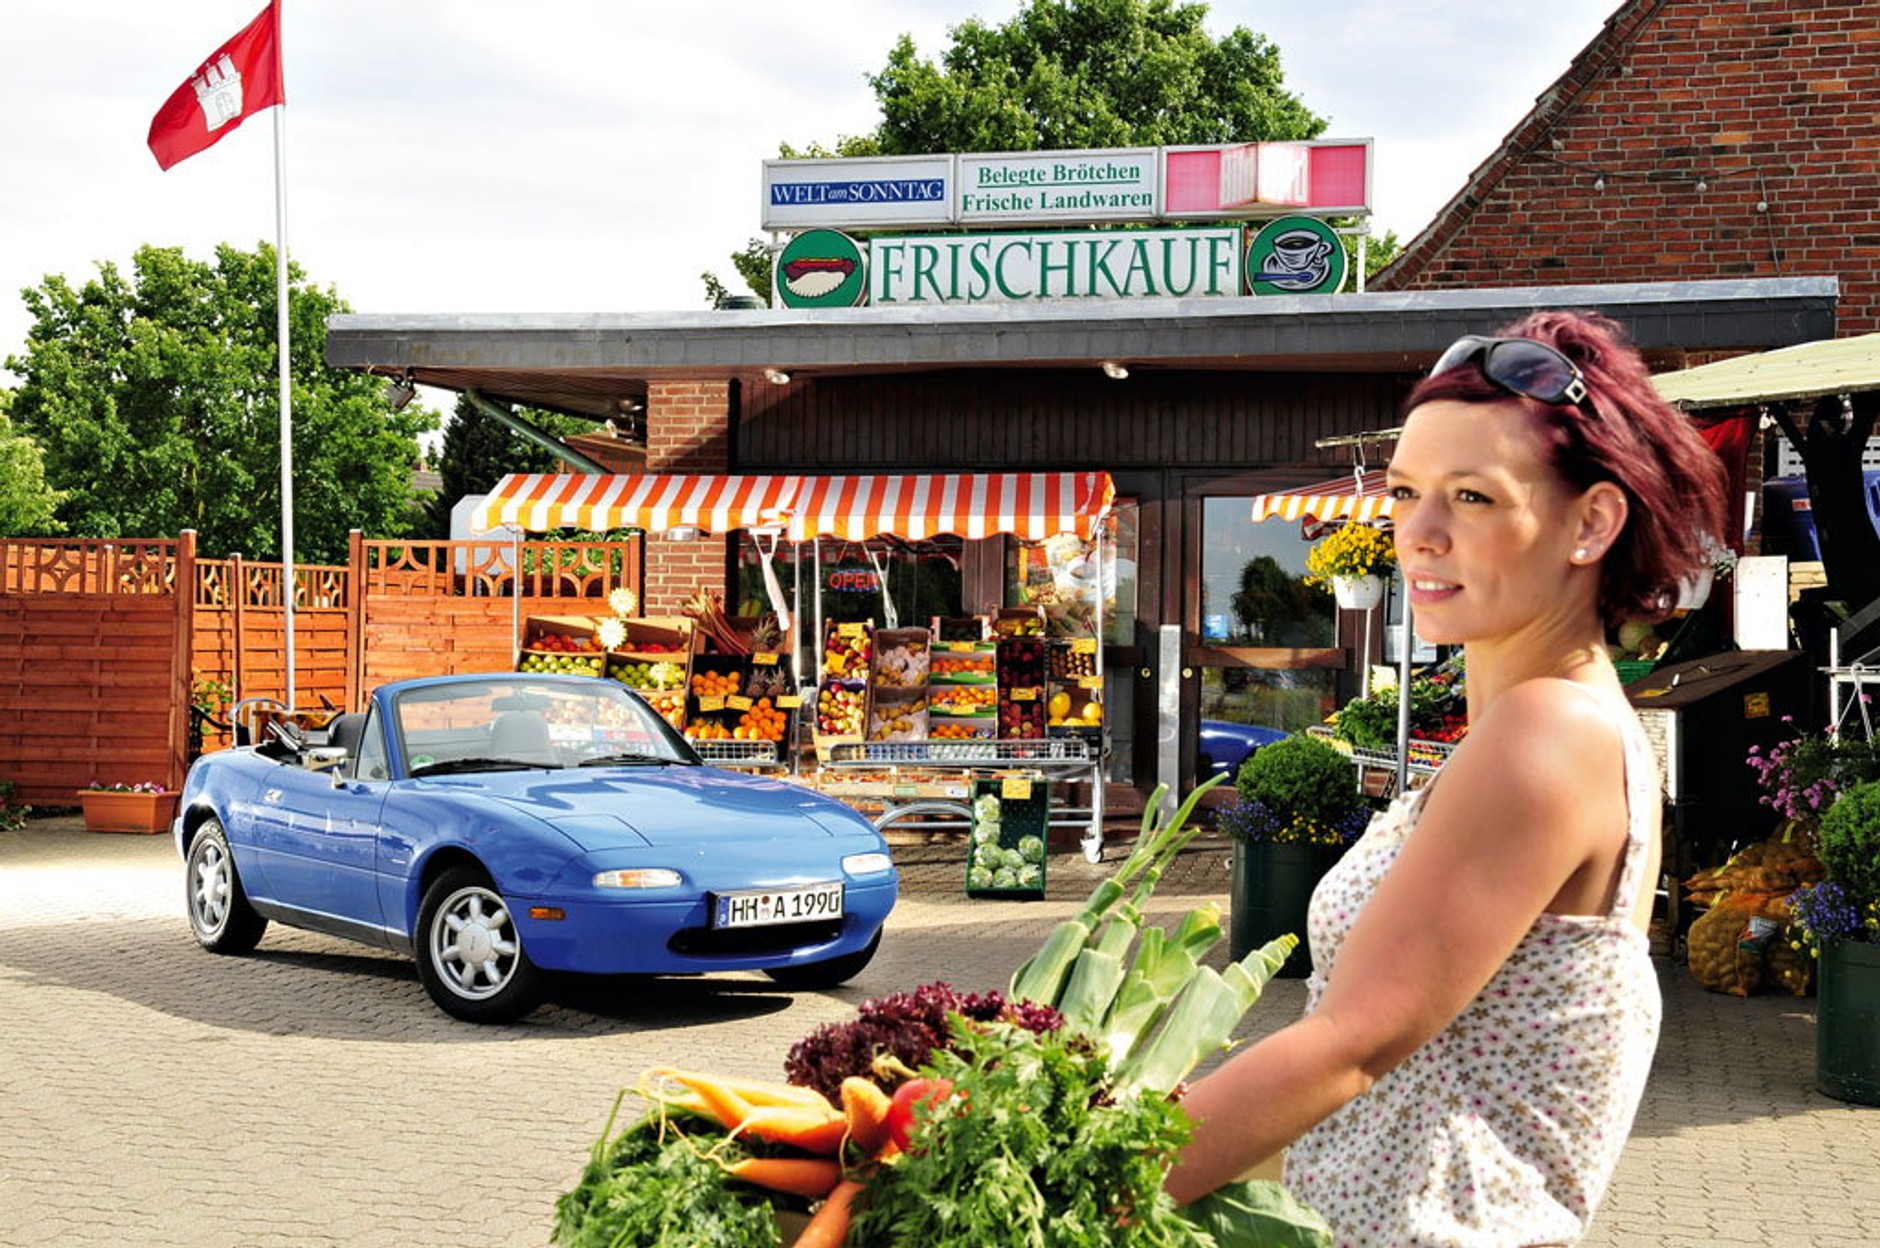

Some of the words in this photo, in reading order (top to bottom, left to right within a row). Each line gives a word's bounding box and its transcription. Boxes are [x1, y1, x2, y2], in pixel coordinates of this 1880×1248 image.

[978, 166, 1046, 186] Belegte
[1053, 163, 1140, 181] Brötchen
[773, 185, 829, 203] WELT
[828, 189, 848, 200] am
[850, 181, 943, 201] SONNTAG
[962, 193, 1033, 212] Frische
[1041, 190, 1152, 210] Landwaren
[878, 231, 1234, 304] FRISCHKAUF
[829, 572, 880, 589] OPEN
[732, 898, 758, 922] HH
[773, 896, 785, 918] A
[791, 891, 840, 917] 1990
